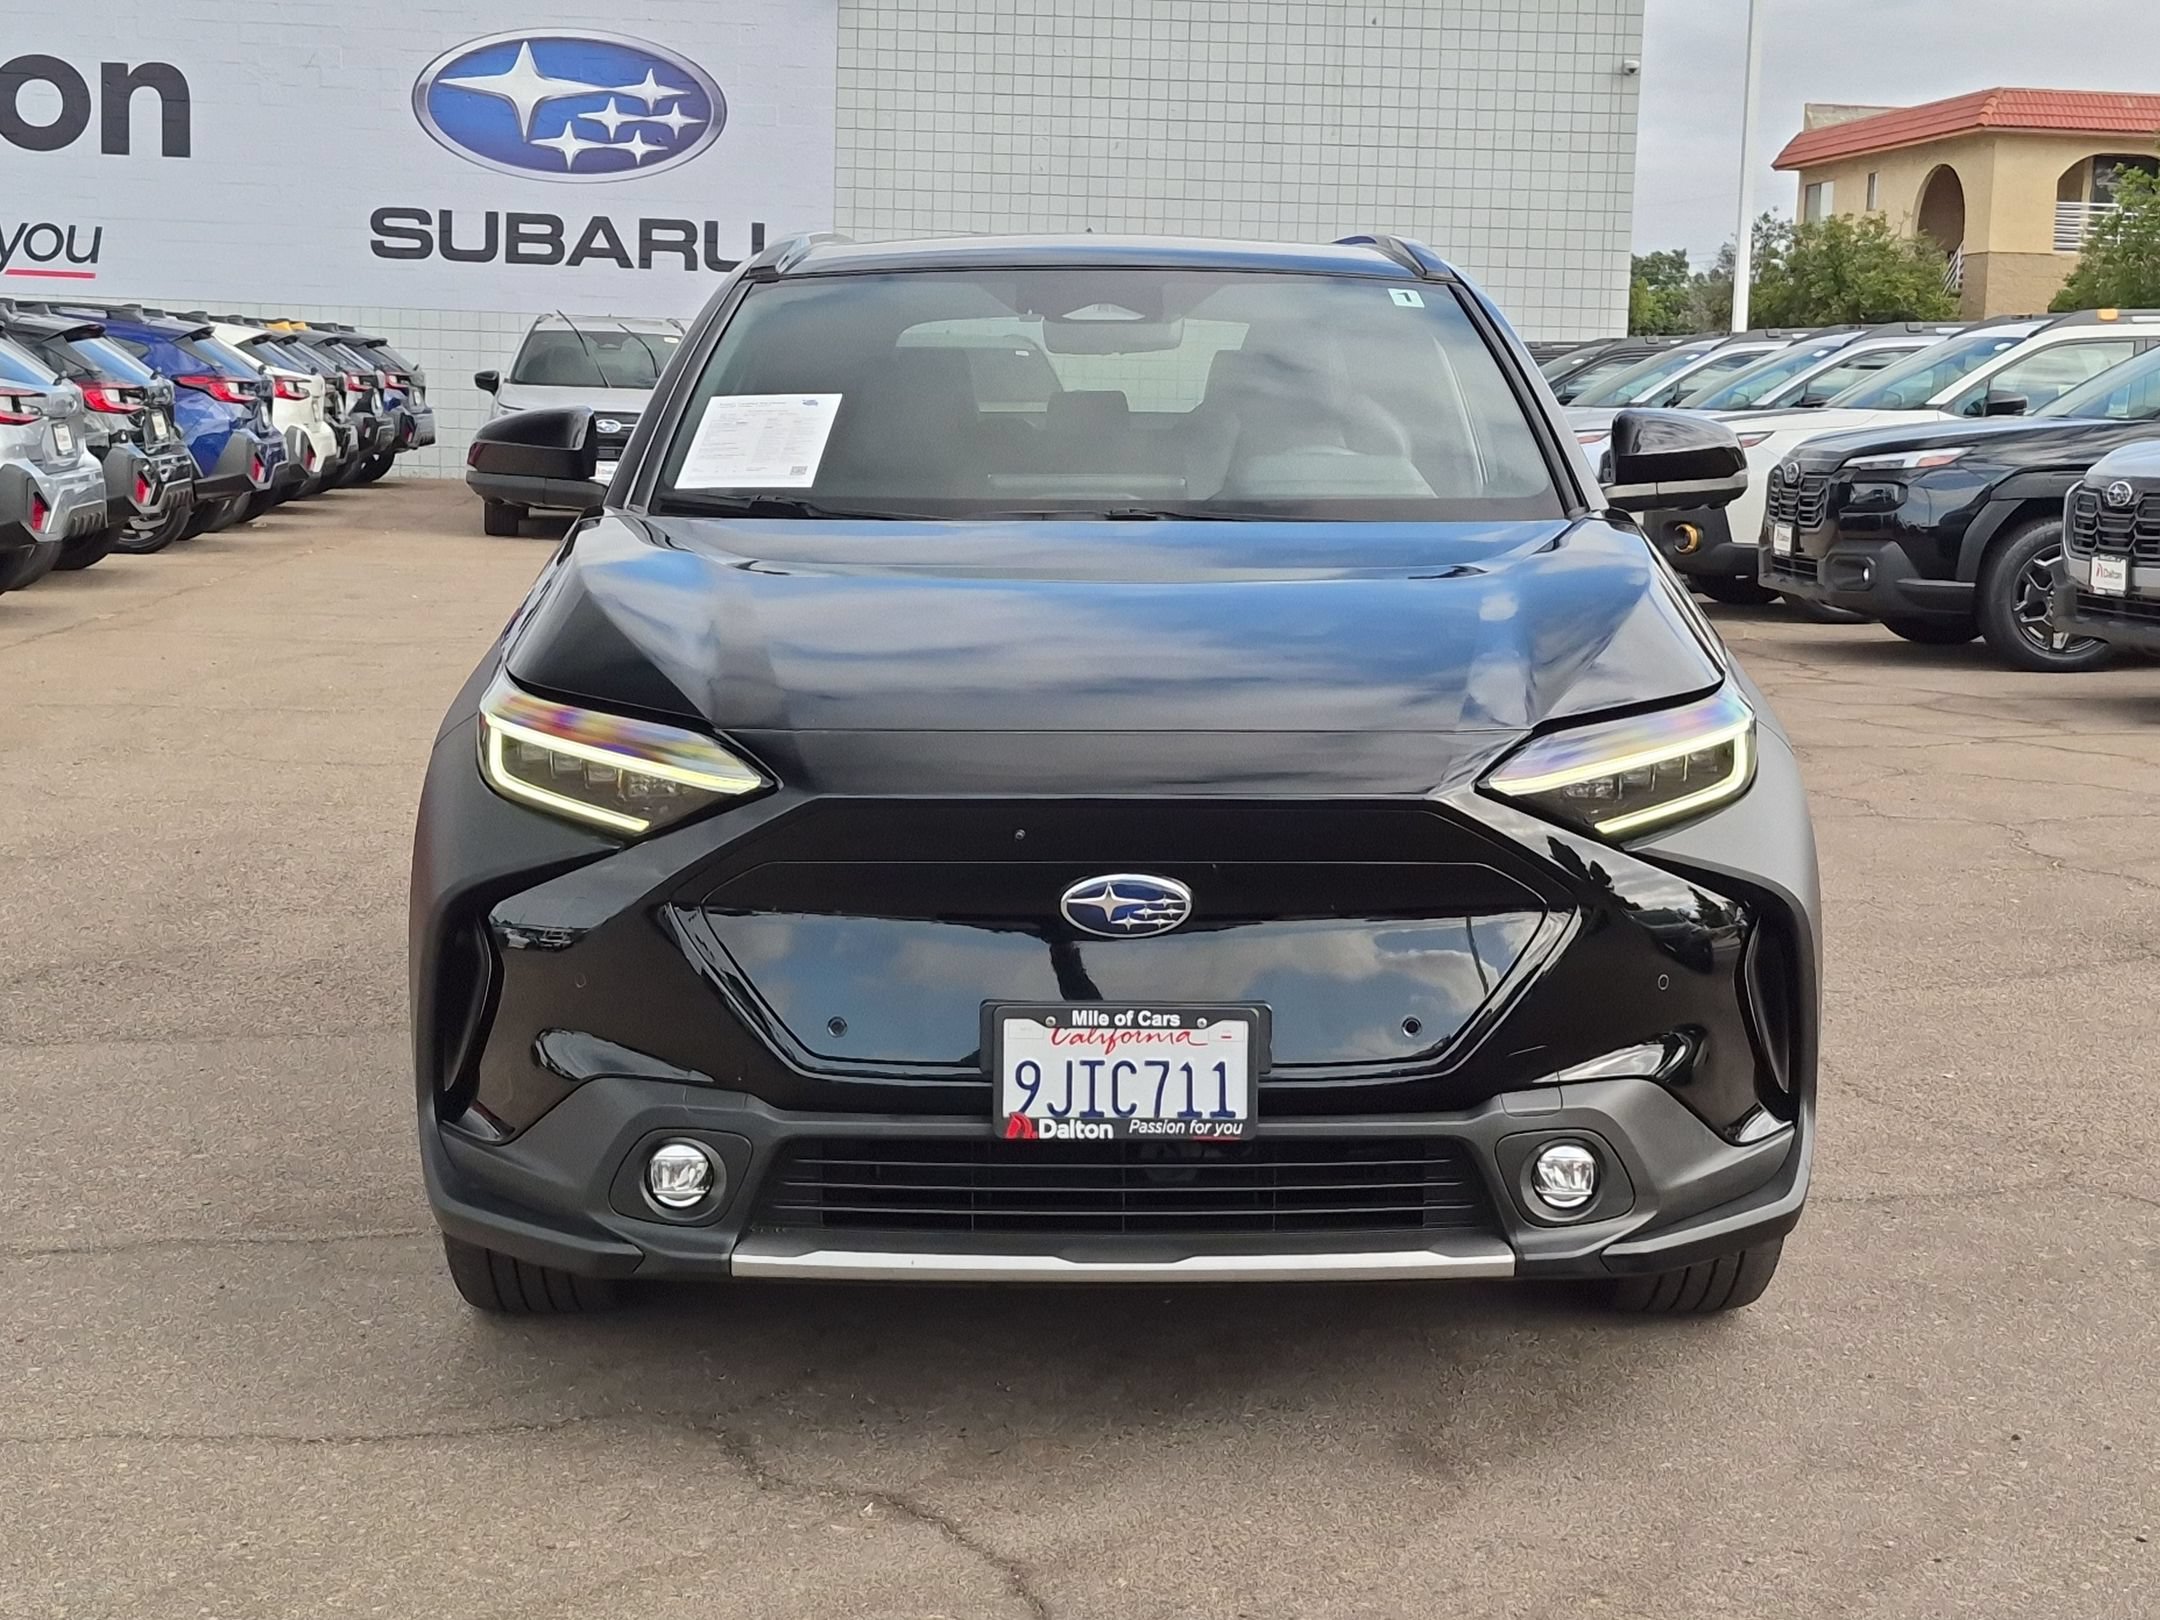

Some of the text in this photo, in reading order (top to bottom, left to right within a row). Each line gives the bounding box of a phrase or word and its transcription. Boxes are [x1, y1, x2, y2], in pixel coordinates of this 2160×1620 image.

[370, 206, 765, 273] SUBARU
[1072, 1010, 1181, 1027] Mile of Cars
[1051, 1026, 1208, 1055] California
[1015, 1060, 1236, 1118] 9JIC711
[1039, 1120, 1114, 1139] Dalton
[1129, 1119, 1242, 1136] Passion for you
